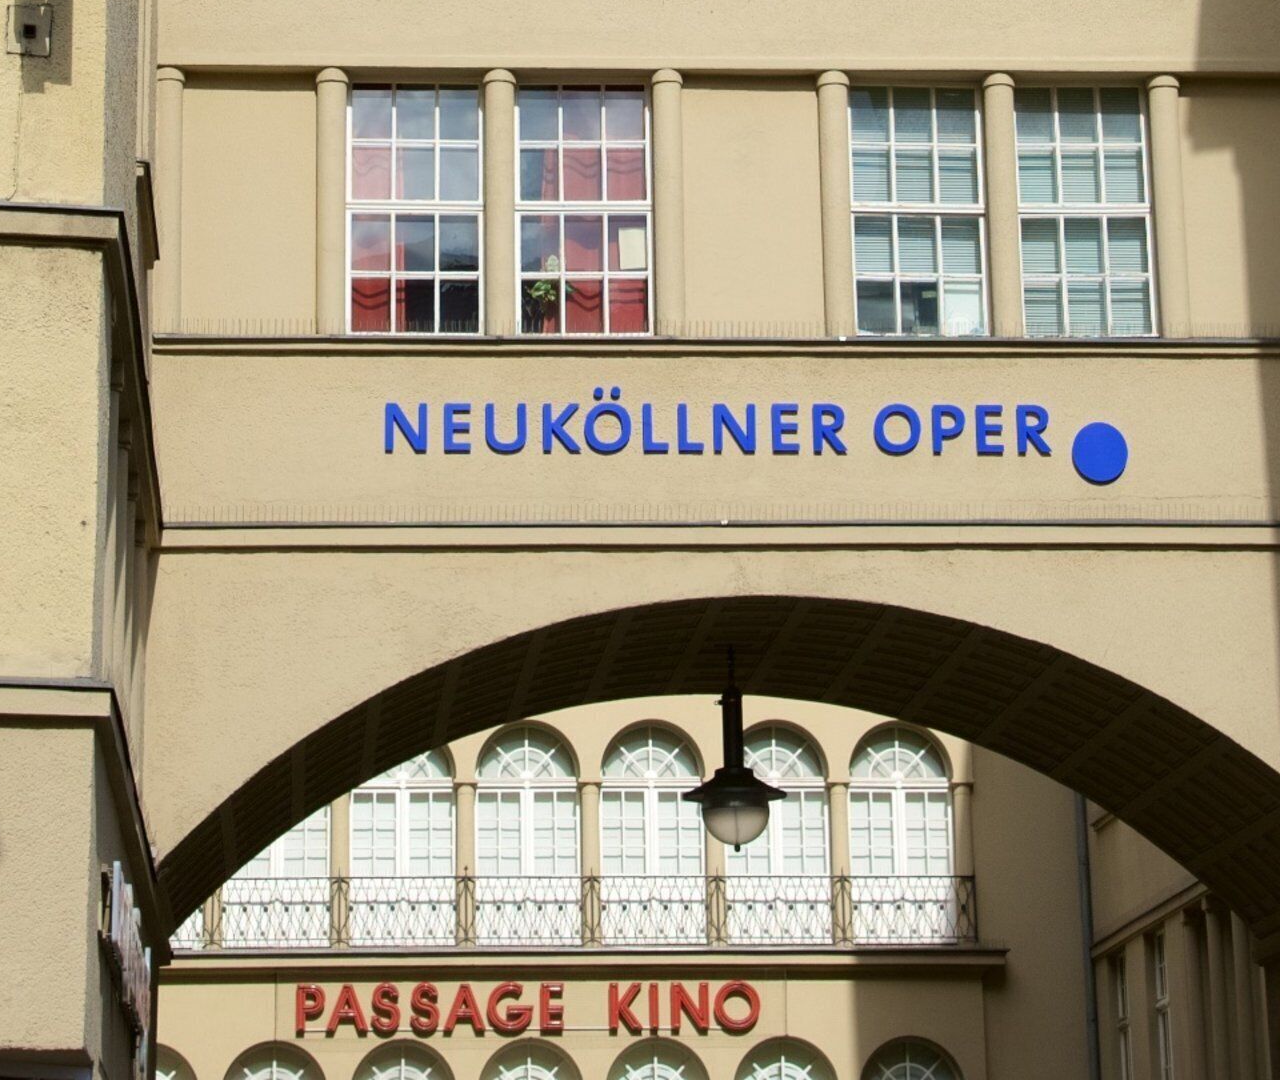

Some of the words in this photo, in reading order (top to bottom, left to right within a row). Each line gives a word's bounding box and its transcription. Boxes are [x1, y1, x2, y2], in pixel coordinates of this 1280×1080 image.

[383, 386, 848, 455] NEUKÖLLNER
[873, 403, 1052, 456] OPER
[295, 982, 565, 1037] PASSAGE
[608, 980, 761, 1037] KINO
